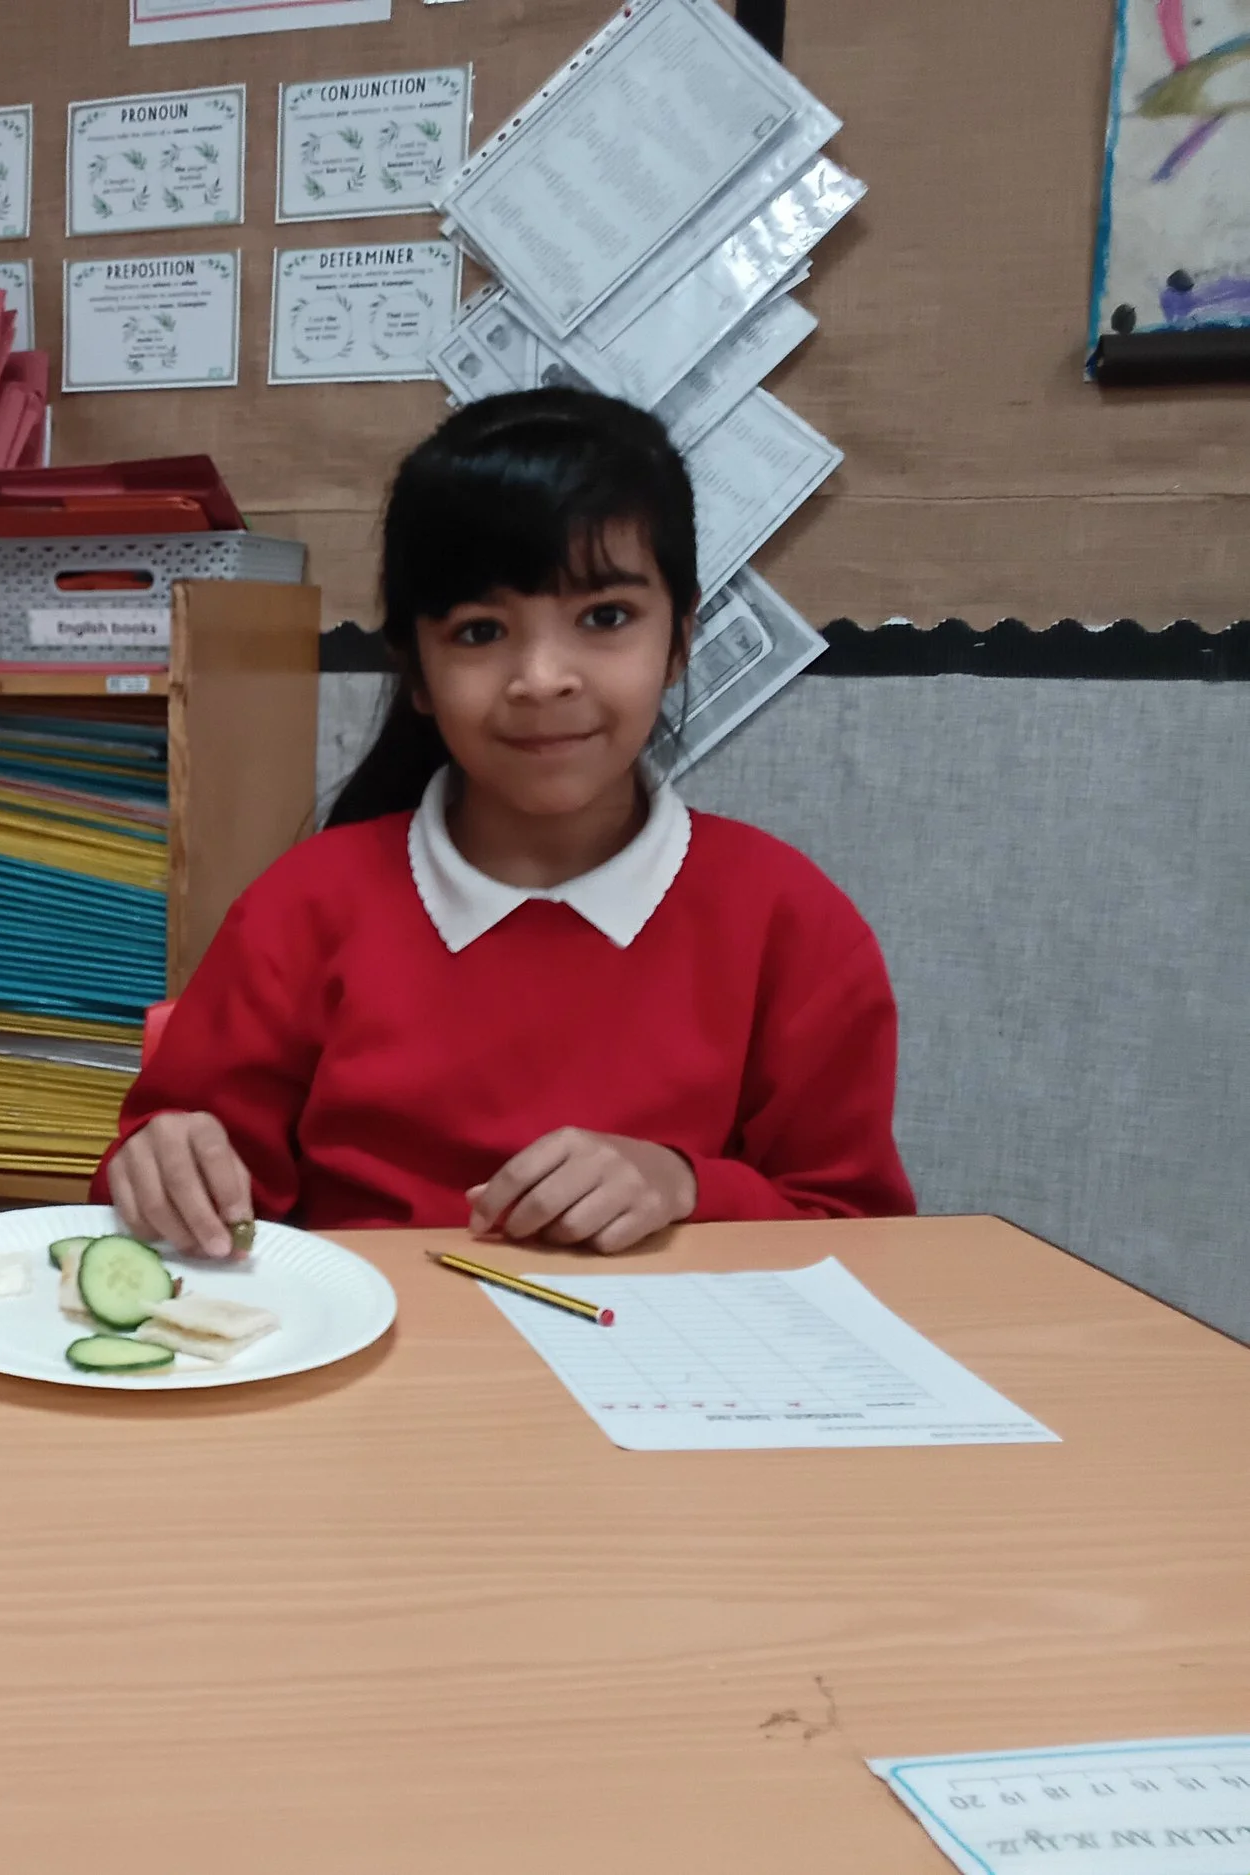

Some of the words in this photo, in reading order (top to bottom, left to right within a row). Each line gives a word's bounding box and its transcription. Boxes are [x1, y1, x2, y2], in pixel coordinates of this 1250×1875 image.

[320, 77, 426, 102] CONJUNCTION
[121, 103, 189, 124] PRONOUN
[319, 247, 414, 269] DETERMINER
[106, 260, 195, 280] PREPOSITION
[57, 620, 107, 640] English
[111, 621, 156, 636] books
[998, 1791, 1028, 1805] 19
[1041, 1786, 1071, 1801] 18
[1090, 1782, 1117, 1796] 17
[949, 1794, 987, 1810] 20
